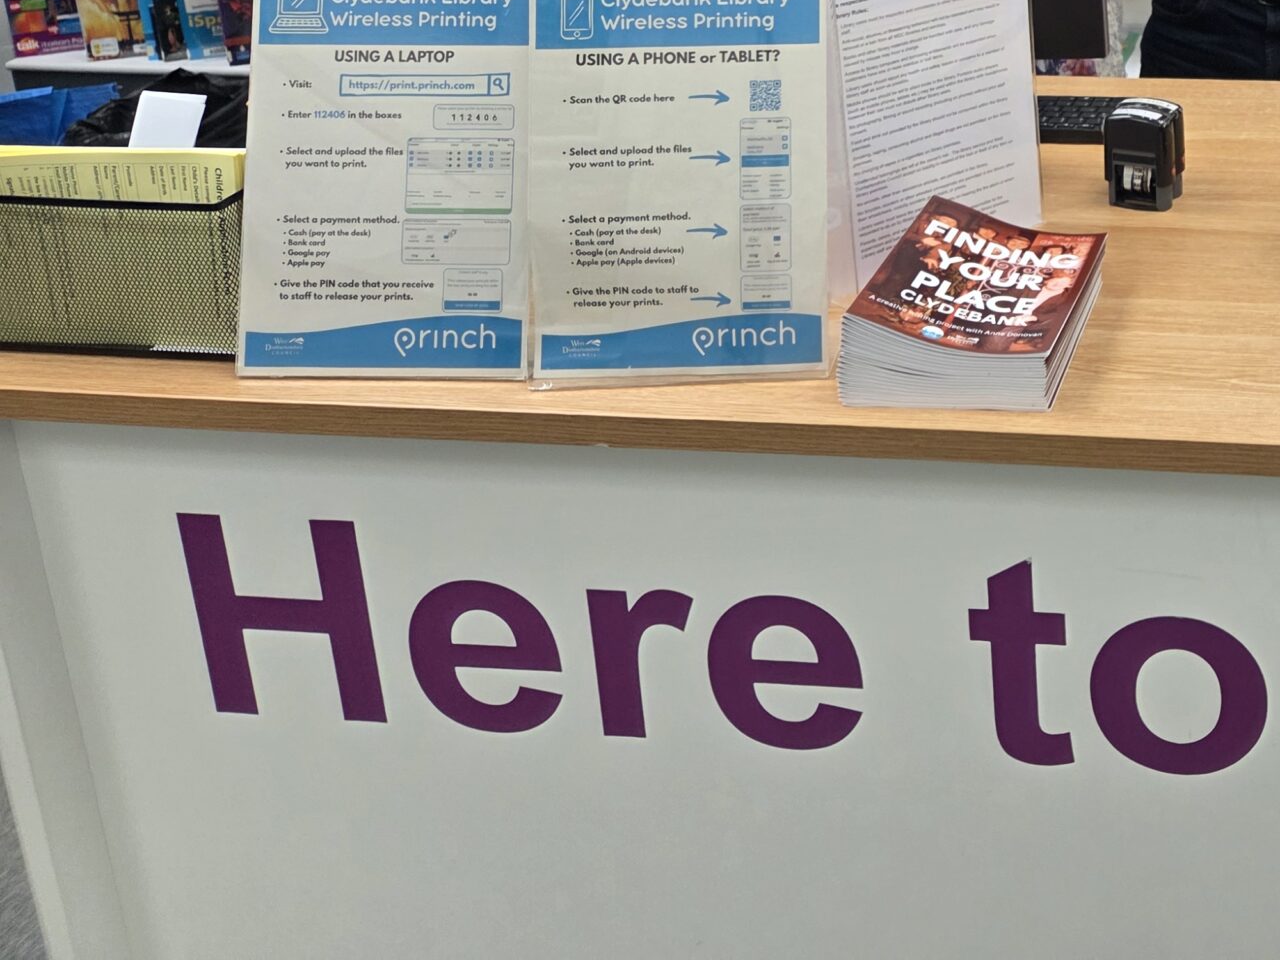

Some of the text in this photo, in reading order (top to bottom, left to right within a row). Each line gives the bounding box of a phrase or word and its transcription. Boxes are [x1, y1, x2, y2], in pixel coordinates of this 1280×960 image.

[330, 11, 496, 31] Wireless Printing
[601, 12, 774, 31] Wireless Printing
[335, 50, 454, 62] USING A LAPTOP
[576, 50, 780, 66] USING A PHONE or TABLET?
[289, 80, 312, 88] Visit:
[349, 80, 474, 91] https://print.princh.com
[570, 94, 674, 104] Scan the QR code here
[288, 110, 312, 118] Enter
[314, 110, 345, 118] 112406
[358, 110, 372, 118] the
[375, 110, 402, 119] boxes
[286, 147, 403, 157] Select and upload the files
[924, 220, 1081, 269] FINDING
[938, 250, 1044, 290] YOUR
[911, 270, 1036, 316] PLACE
[900, 289, 1030, 327] CLYDEBANK
[394, 324, 496, 357] princh
[692, 320, 796, 356] princh
[176, 512, 864, 752] Here
[968, 558, 1268, 775] to
